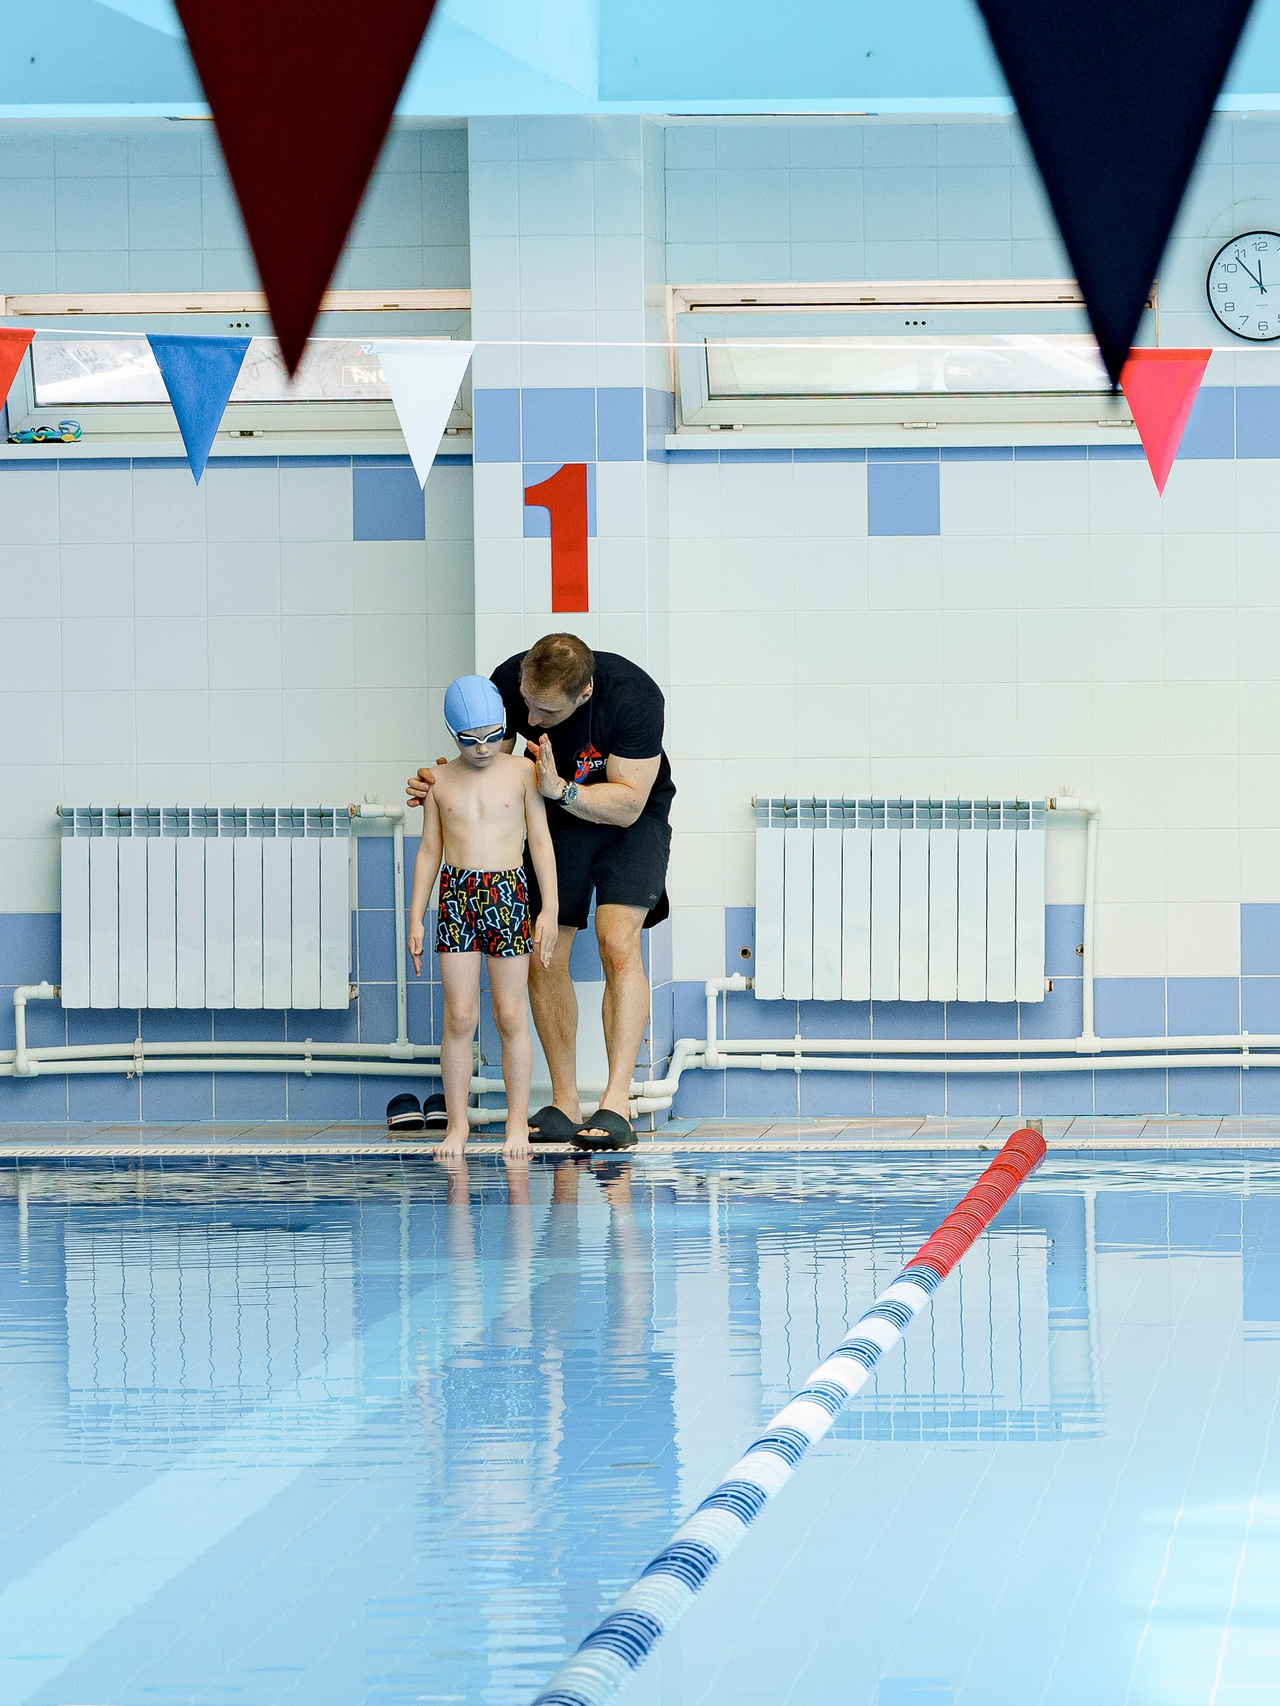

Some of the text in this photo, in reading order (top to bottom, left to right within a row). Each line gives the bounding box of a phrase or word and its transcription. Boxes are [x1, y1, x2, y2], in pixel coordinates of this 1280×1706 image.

[1251, 241, 1268, 251] 12
[1234, 249, 1246, 258] 11
[1221, 263, 1237, 273] 10
[1217, 283, 1228, 293] 9
[1224, 302, 1235, 312] 8
[1239, 315, 1250, 326] 7
[1258, 321, 1268, 331] 6
[524, 463, 588, 613] 1
